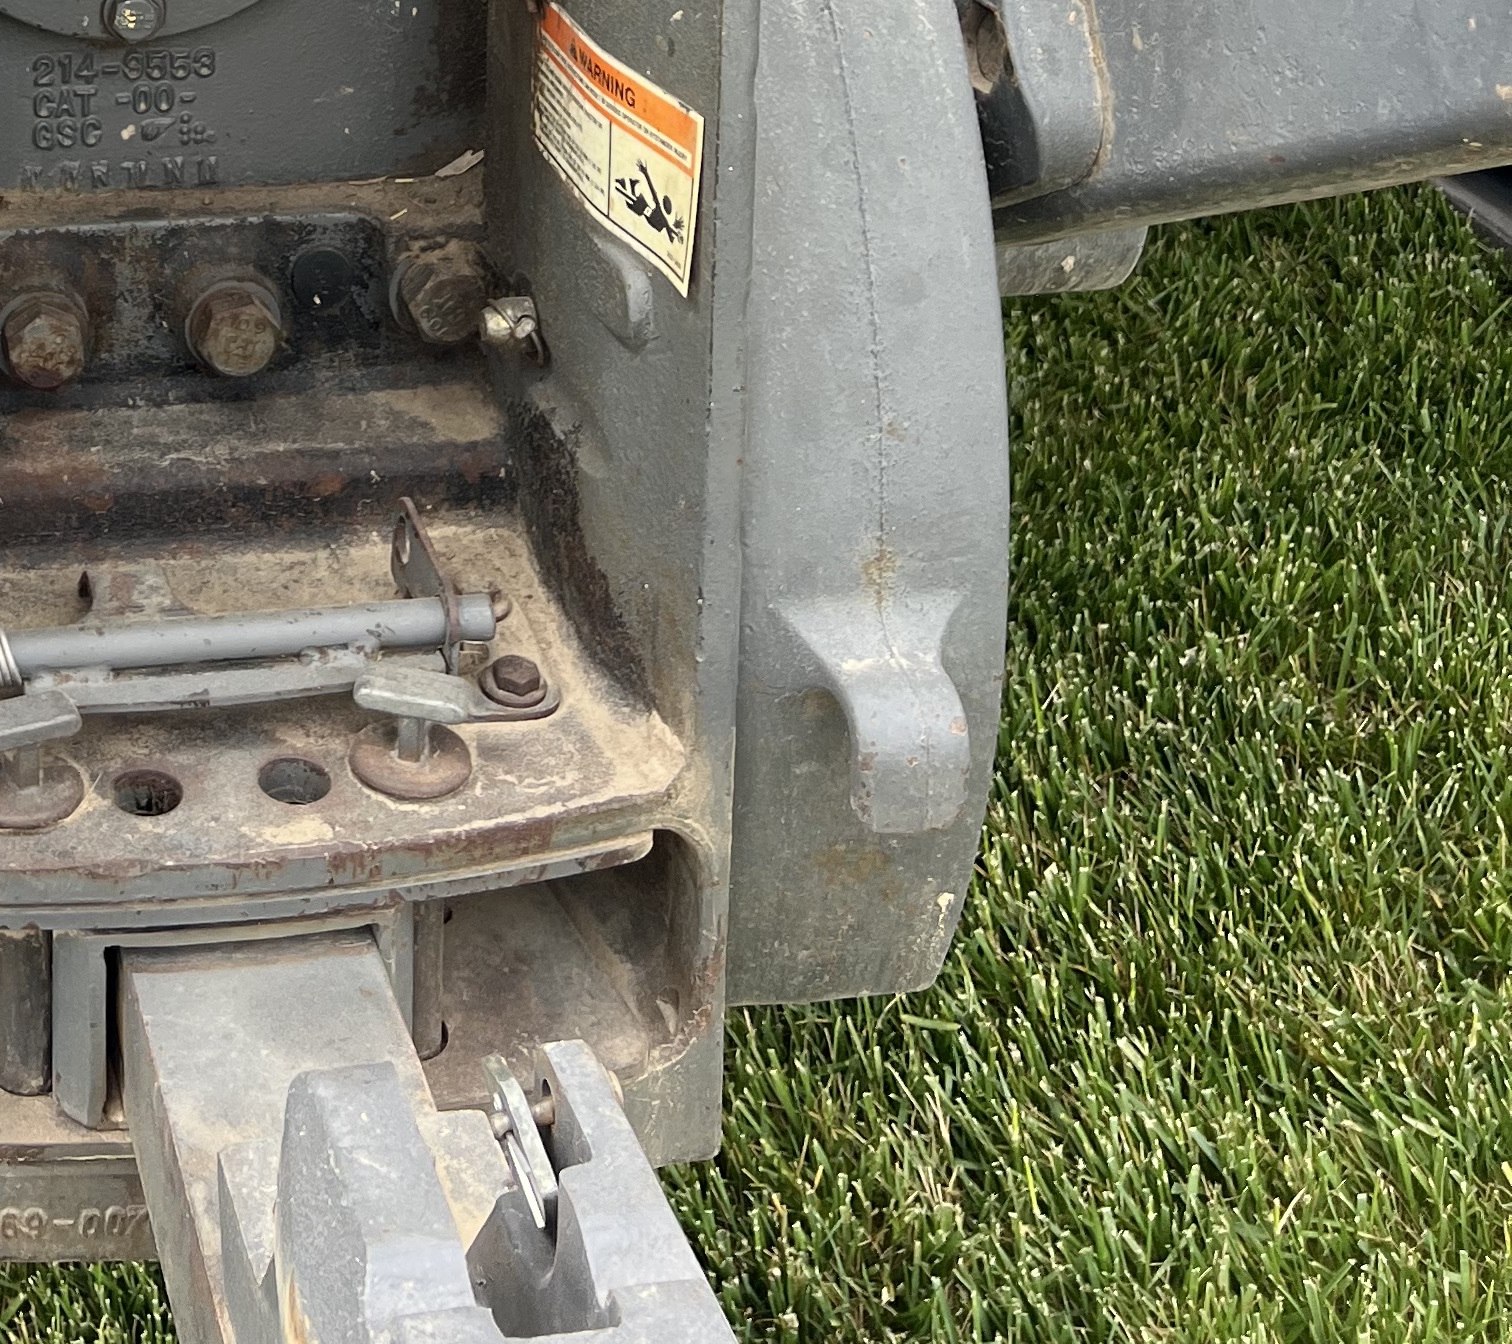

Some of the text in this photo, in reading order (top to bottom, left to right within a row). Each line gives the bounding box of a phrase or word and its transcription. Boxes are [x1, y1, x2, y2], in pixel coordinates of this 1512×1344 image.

[33, 45, 216, 87] 214-9553
[578, 46, 636, 109] WARNING
[33, 85, 99, 119] CAT
